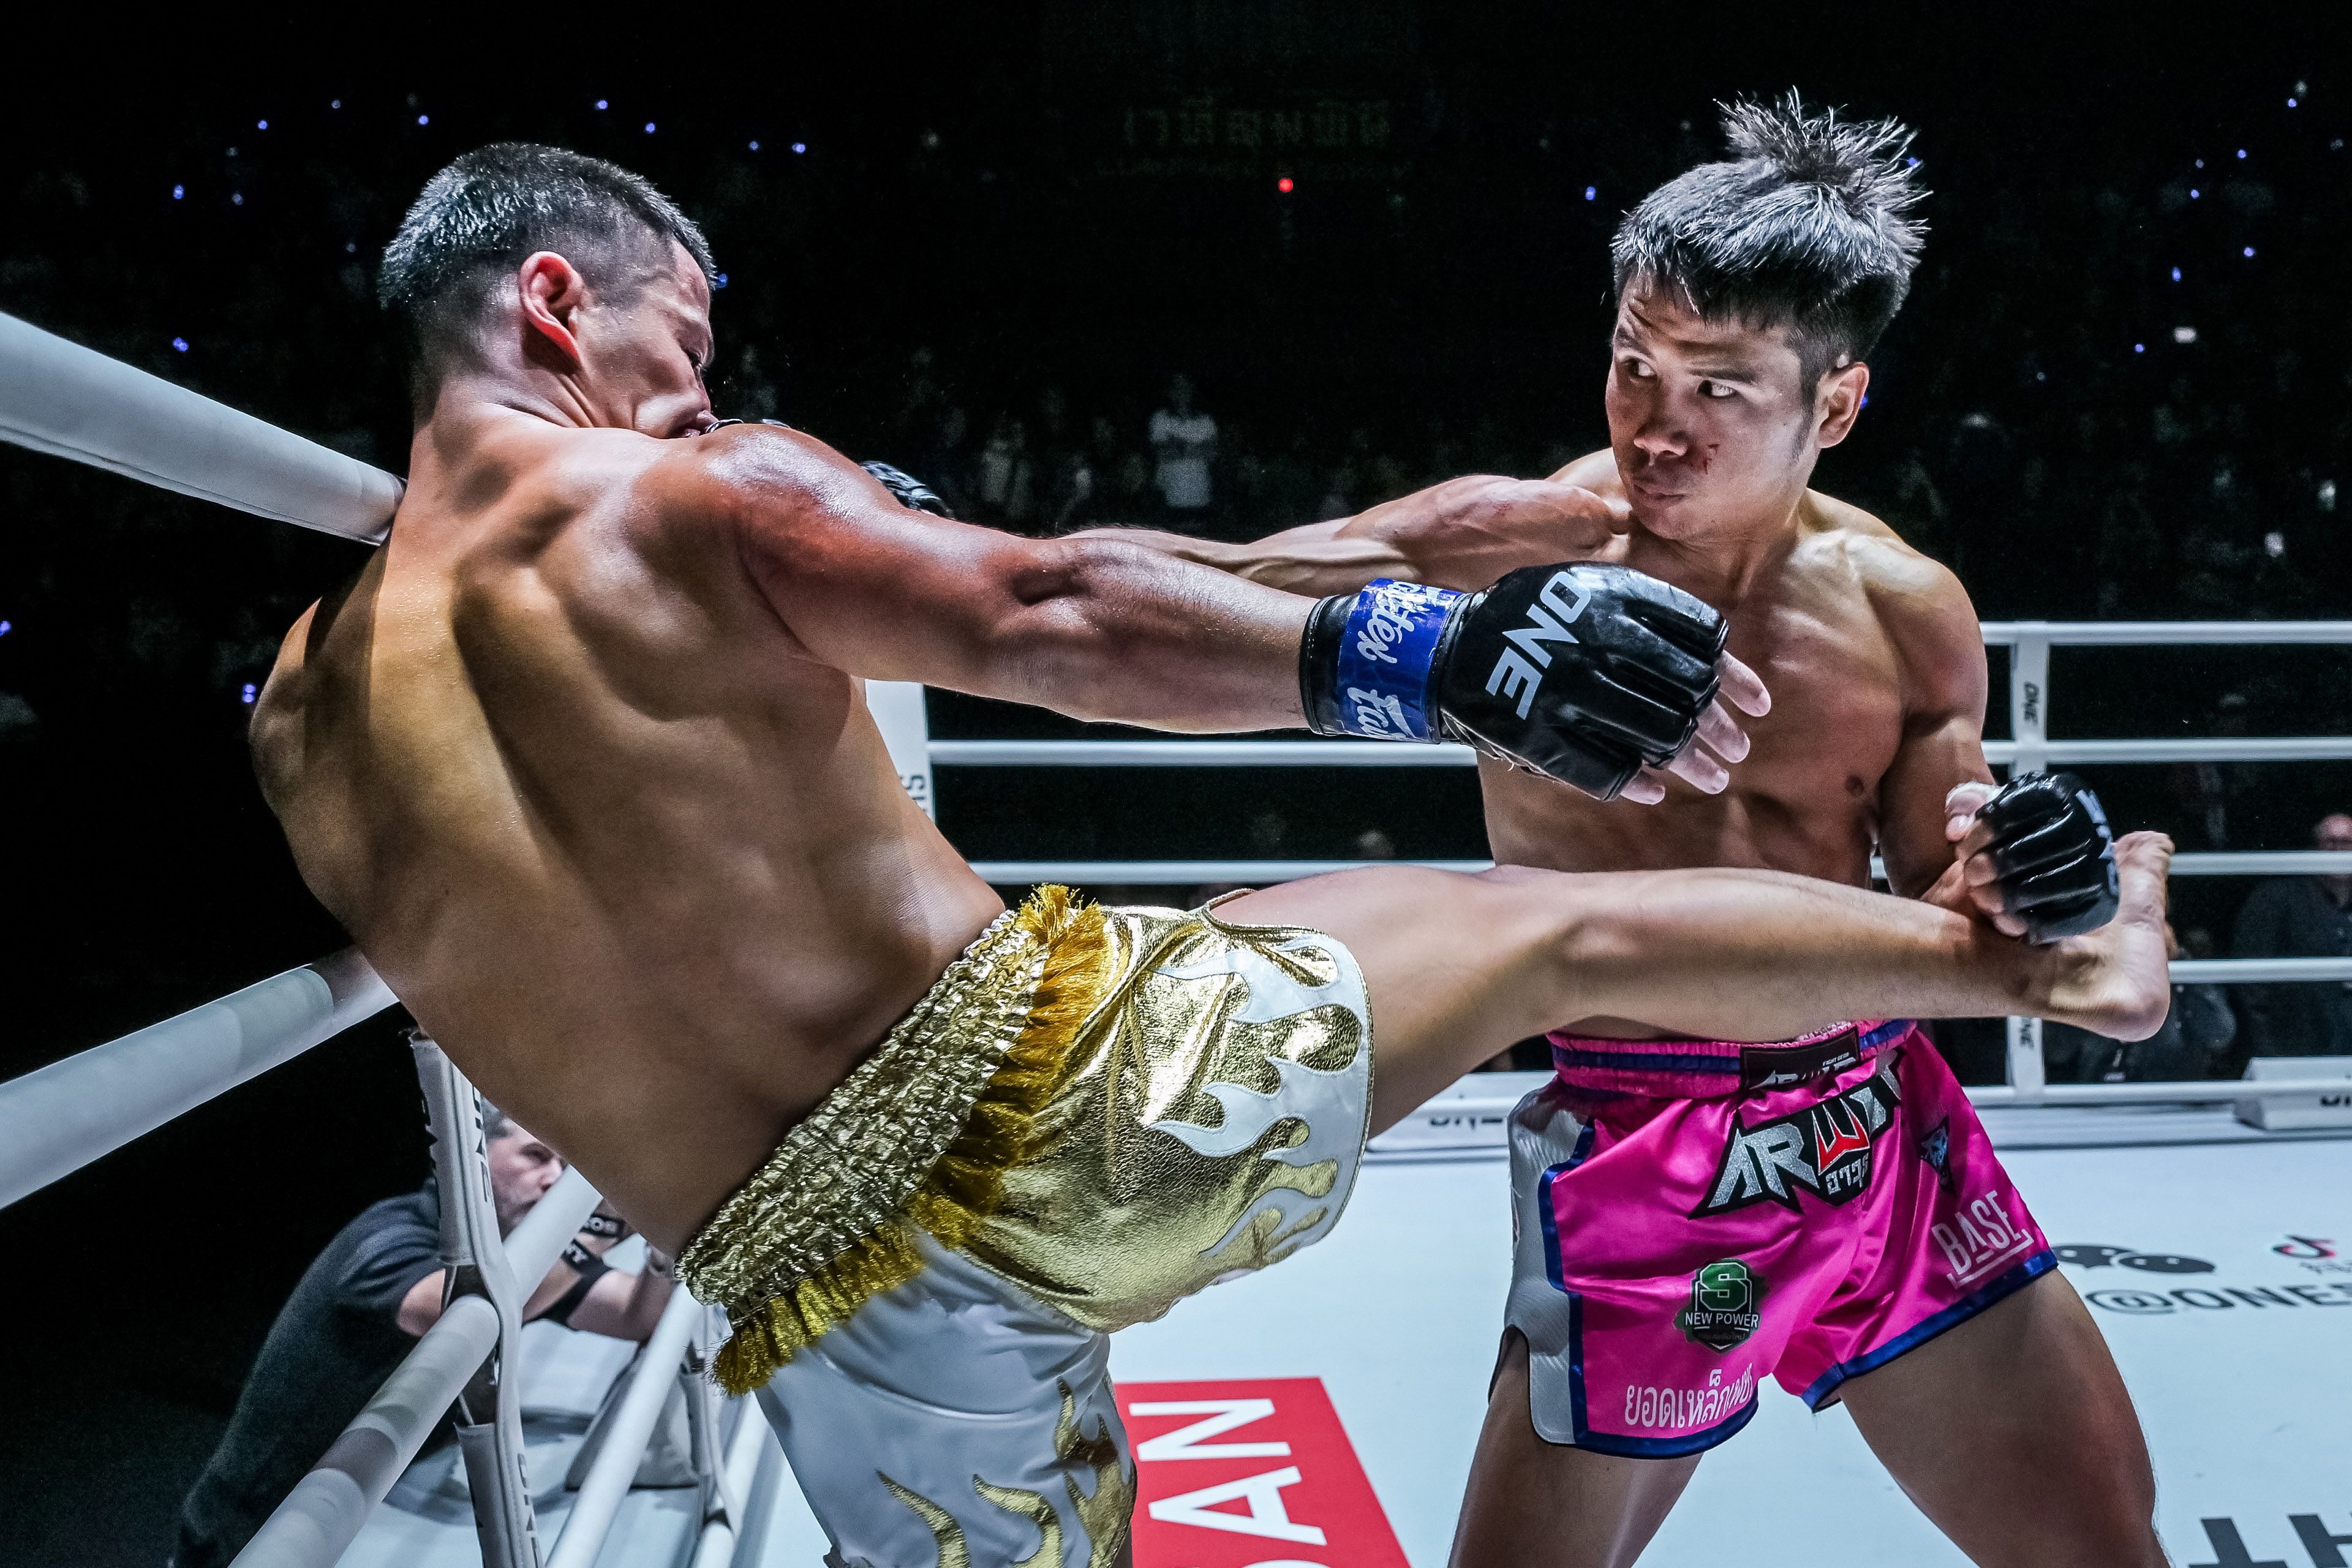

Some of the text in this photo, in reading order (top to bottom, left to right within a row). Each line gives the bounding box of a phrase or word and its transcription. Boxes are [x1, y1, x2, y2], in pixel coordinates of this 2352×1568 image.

[1485, 571, 1592, 720] ONE
[2023, 680, 2039, 725] ONE
[1931, 1190, 2022, 1276] BASE
[1685, 1311, 1759, 1329] NEW POWER
[1700, 1262, 1747, 1311] S
[1129, 1398, 1337, 1568] AN
